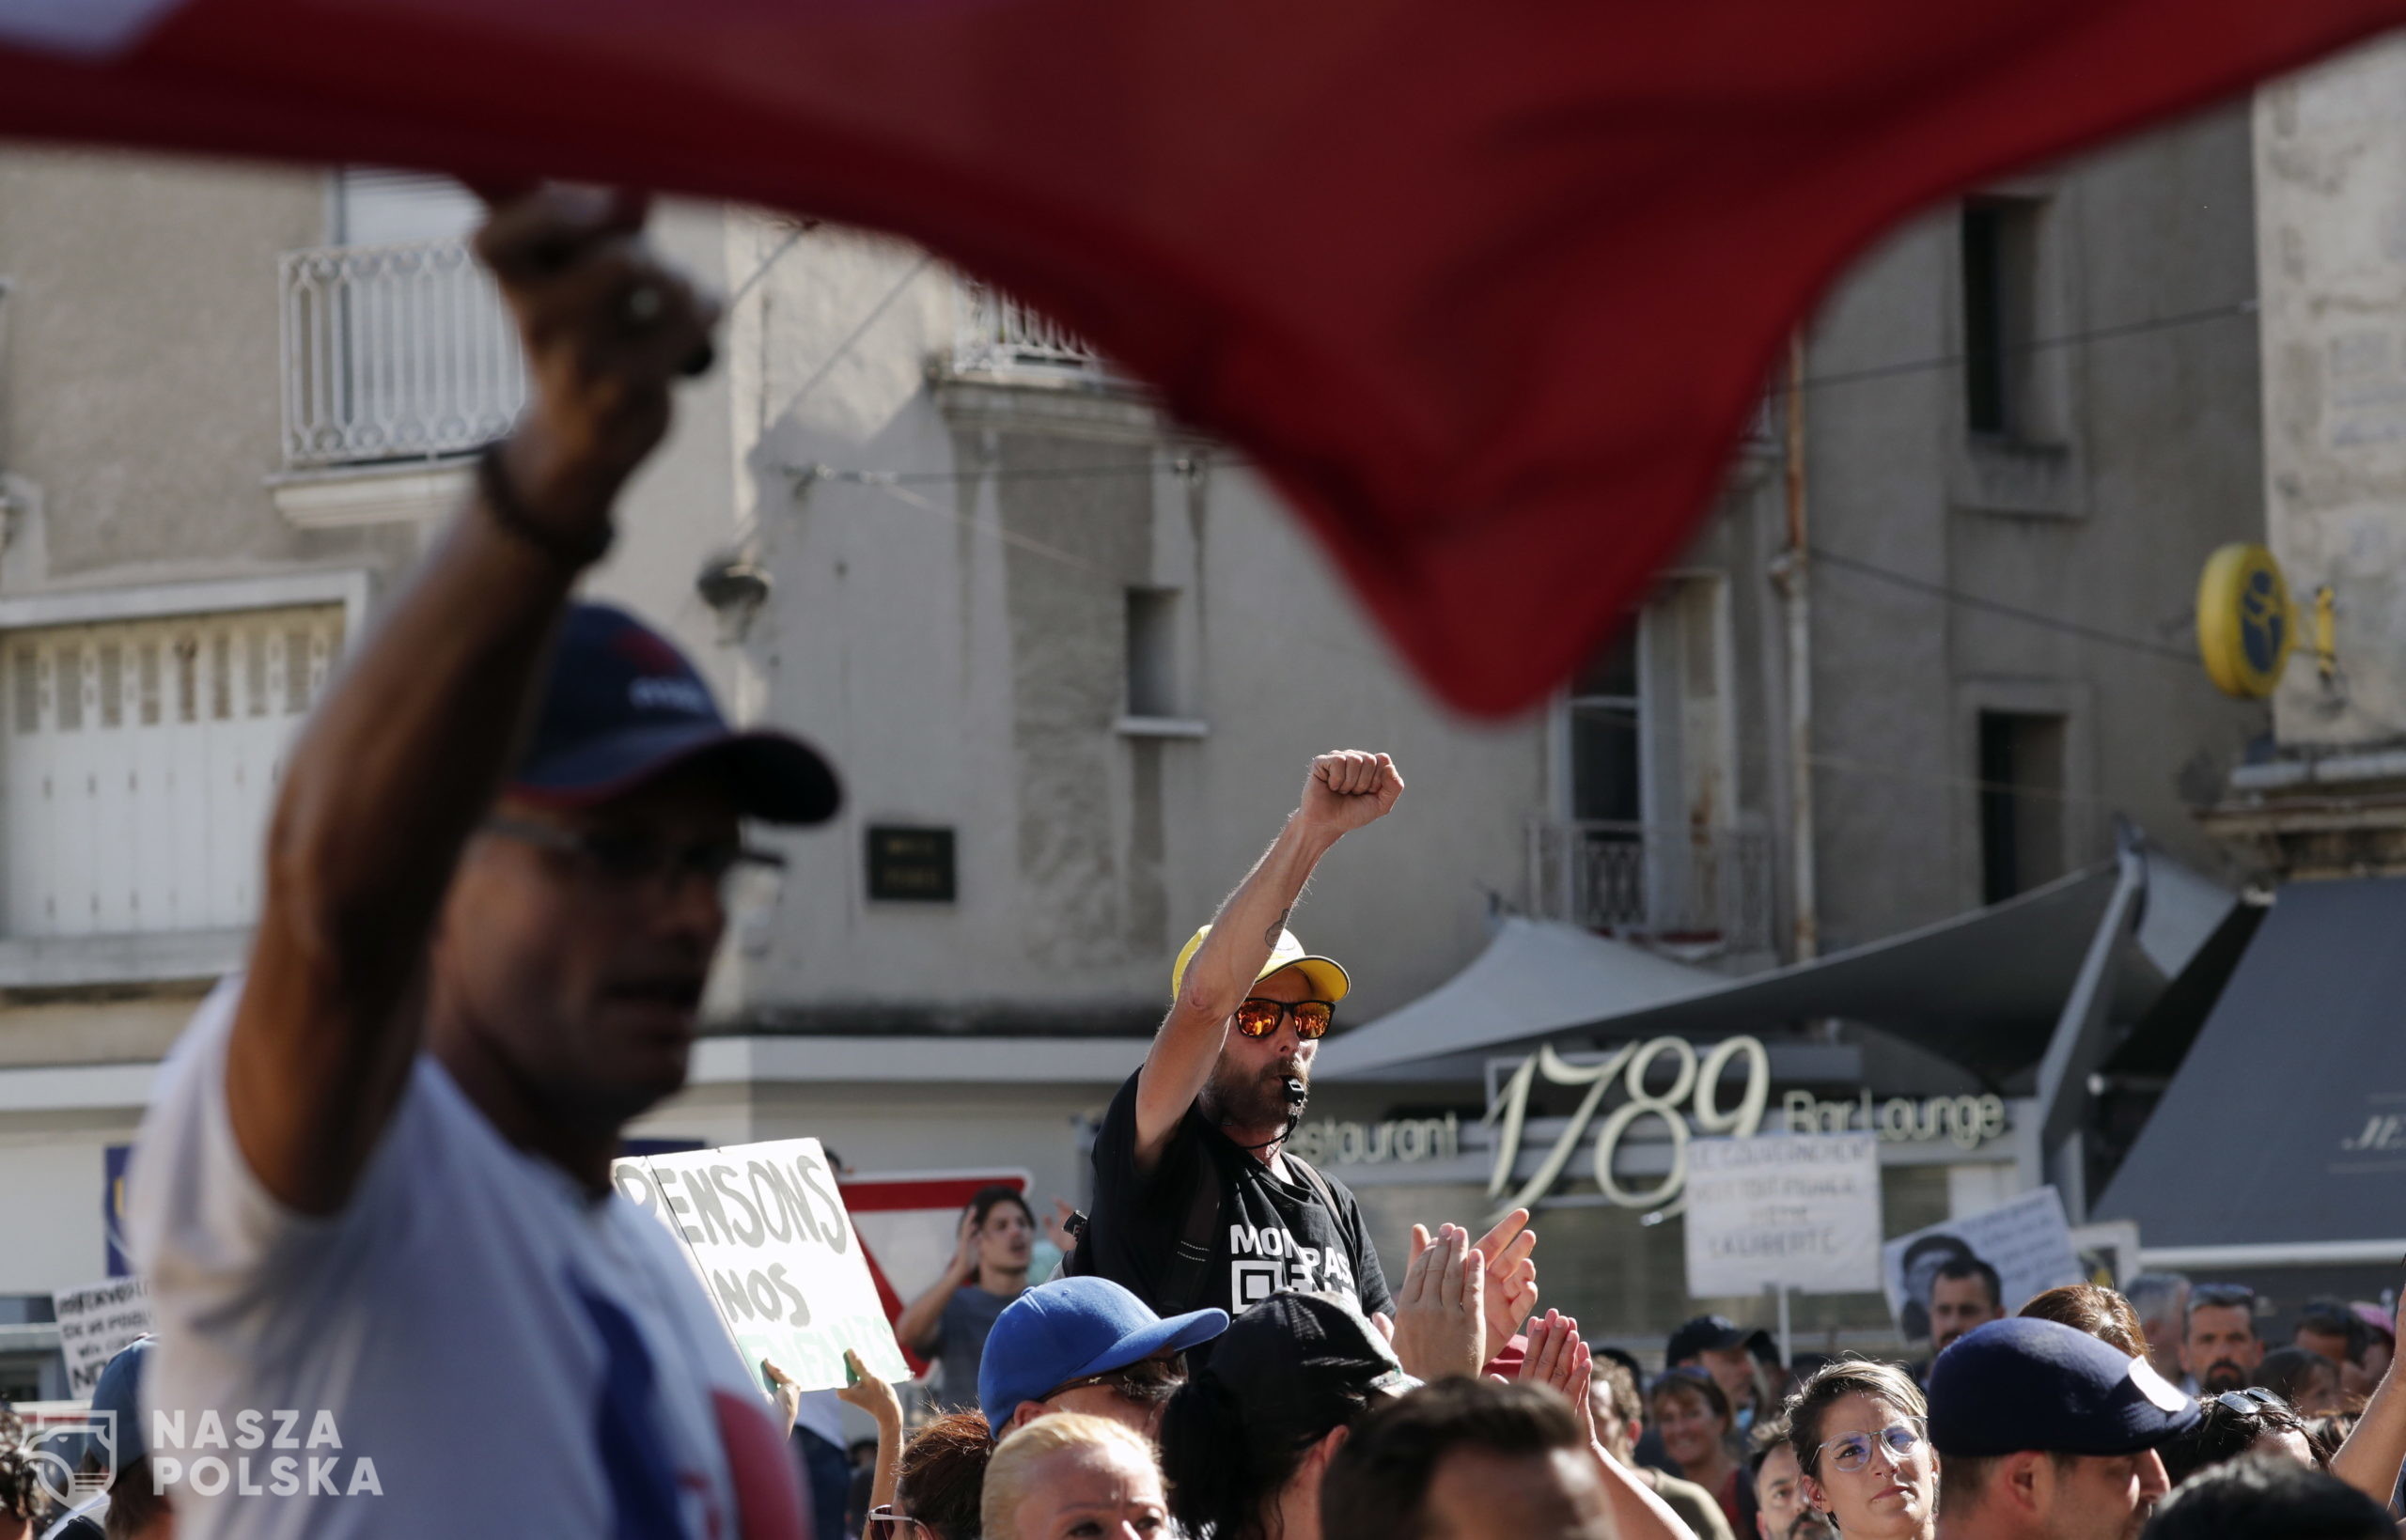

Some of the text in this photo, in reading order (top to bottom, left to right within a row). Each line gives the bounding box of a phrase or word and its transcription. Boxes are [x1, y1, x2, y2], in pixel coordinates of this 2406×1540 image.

[1284, 1110, 1457, 1165] estaurant
[1481, 1035, 1770, 1225] 1789
[1861, 1087, 2005, 1149] Lounge
[616, 1154, 847, 1254] PENSONS
[712, 1262, 811, 1329] NOS
[1297, 1247, 1355, 1289] PAS
